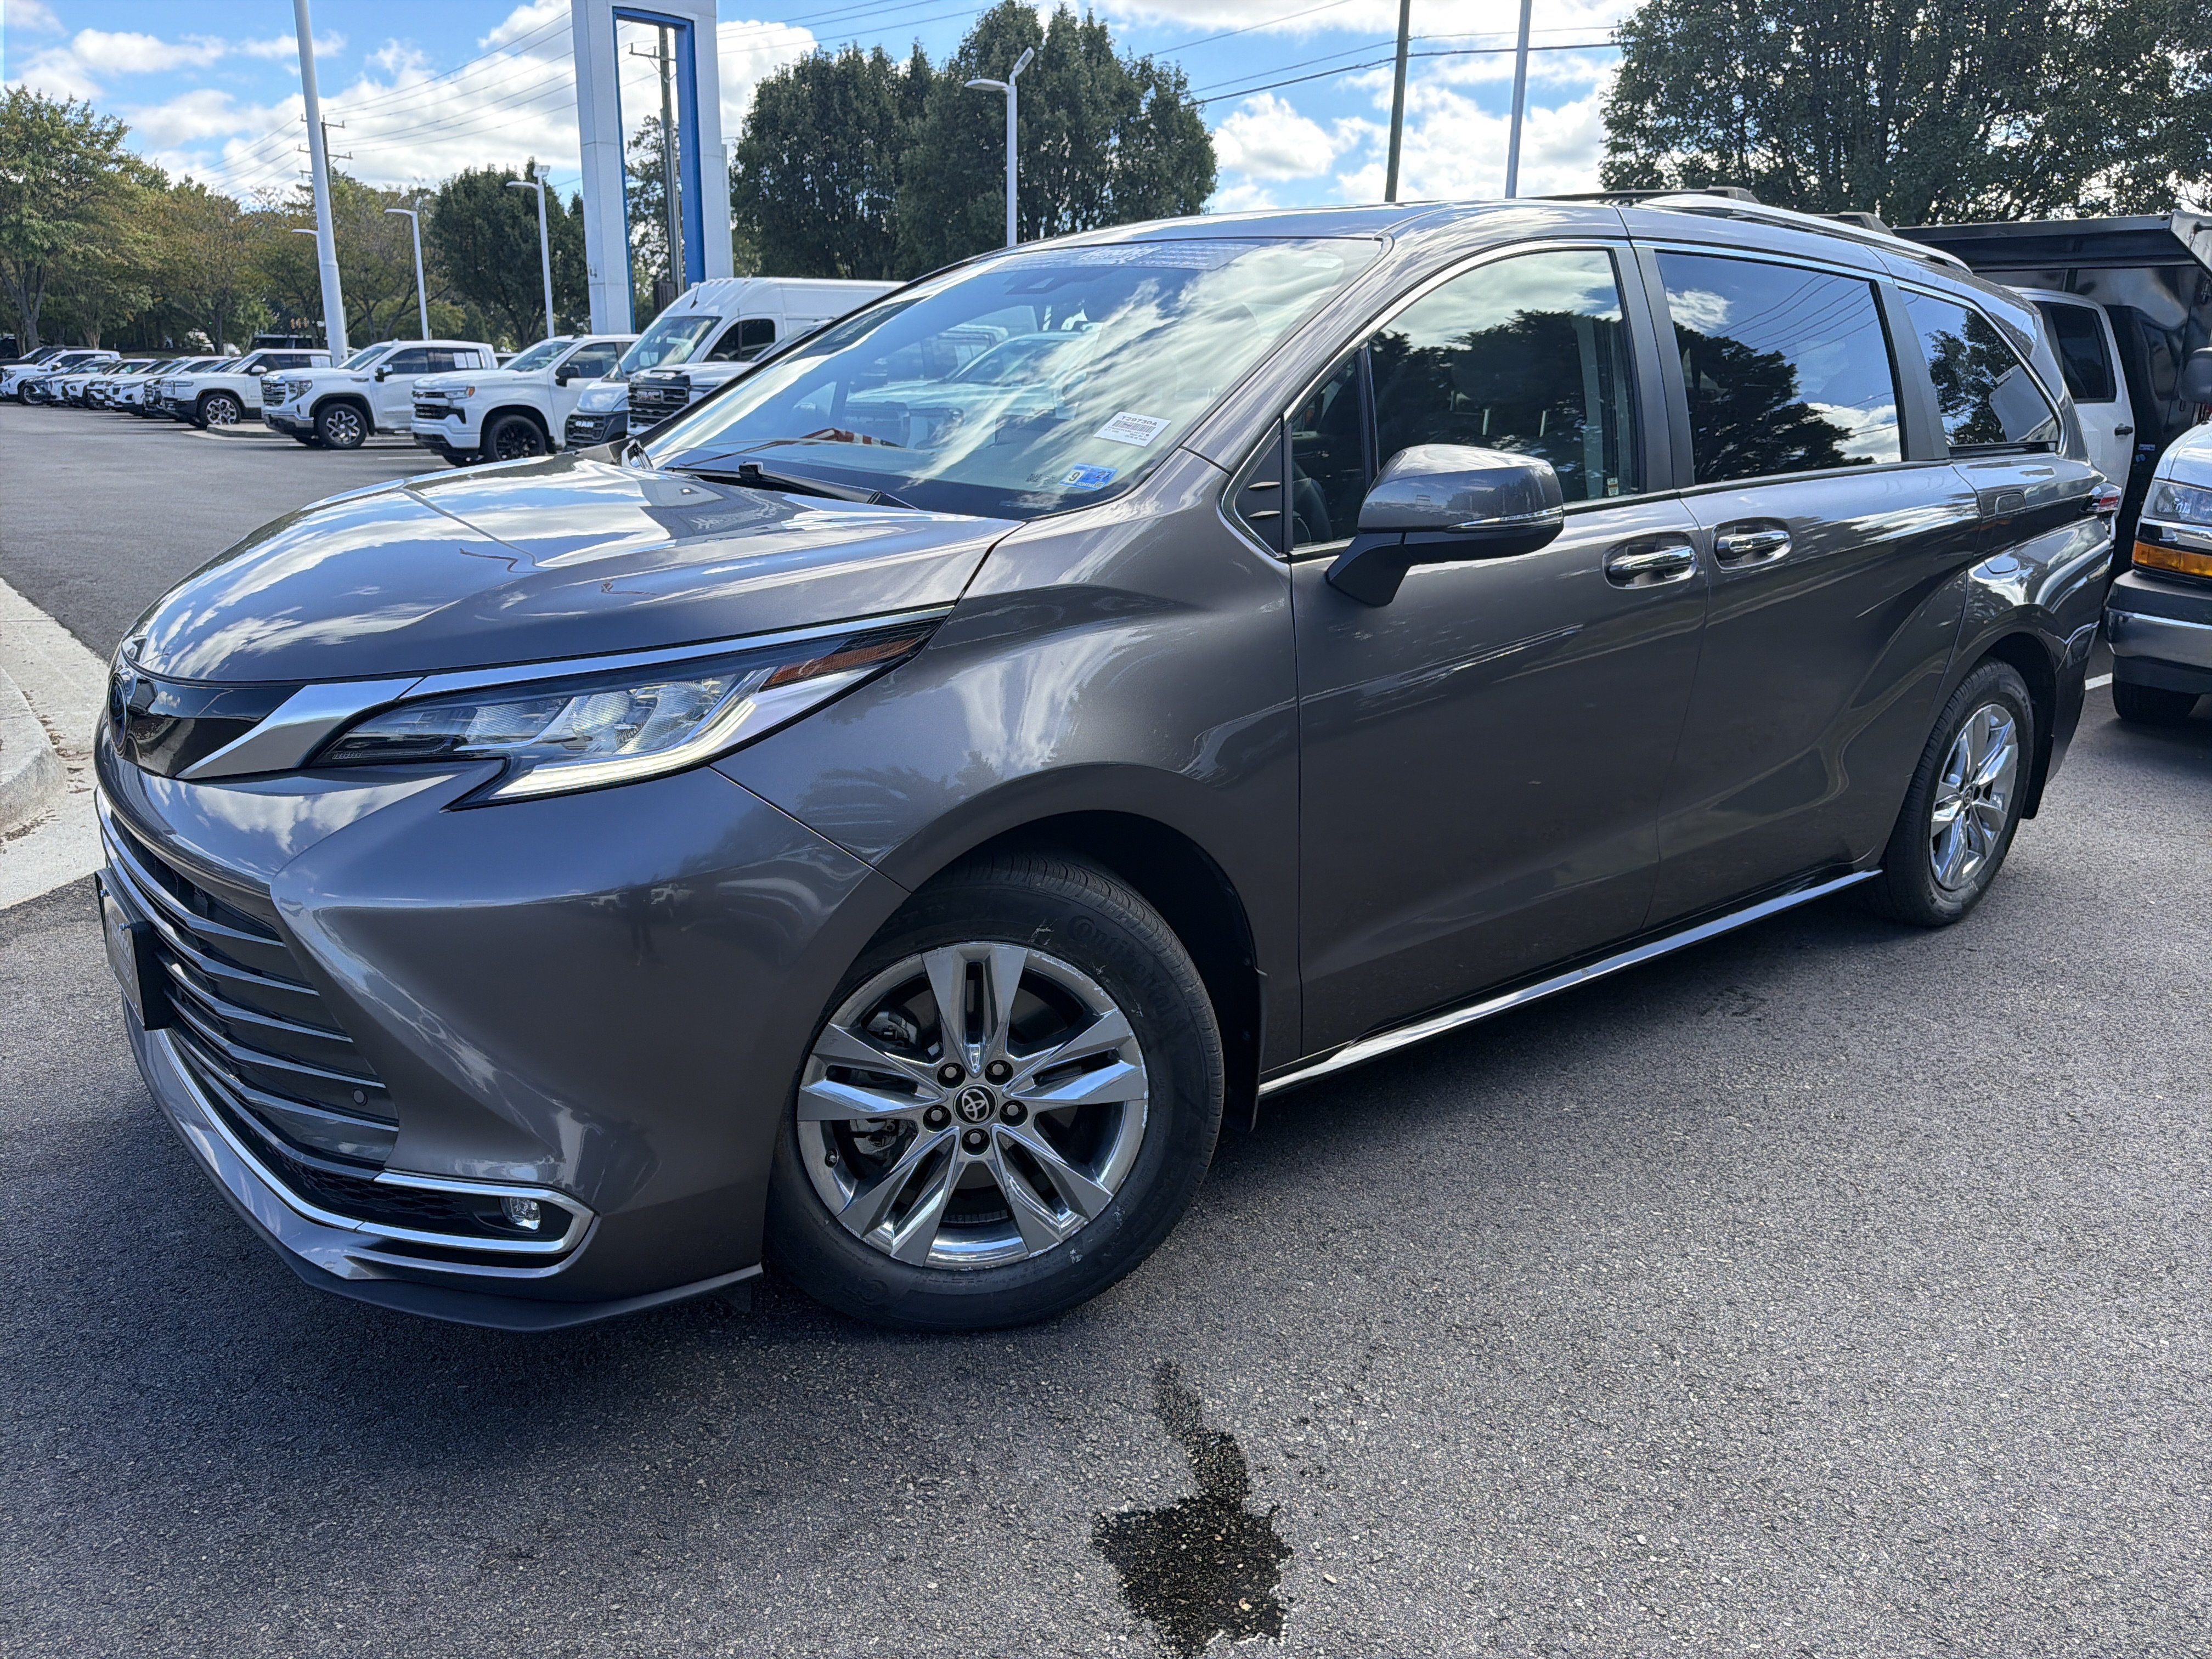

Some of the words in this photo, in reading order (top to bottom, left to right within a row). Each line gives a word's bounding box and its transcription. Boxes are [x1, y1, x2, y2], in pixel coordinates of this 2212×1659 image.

[1121, 415, 1158, 426] T29730A
[1069, 472, 1081, 482] 9
[1096, 471, 1113, 480] 27
